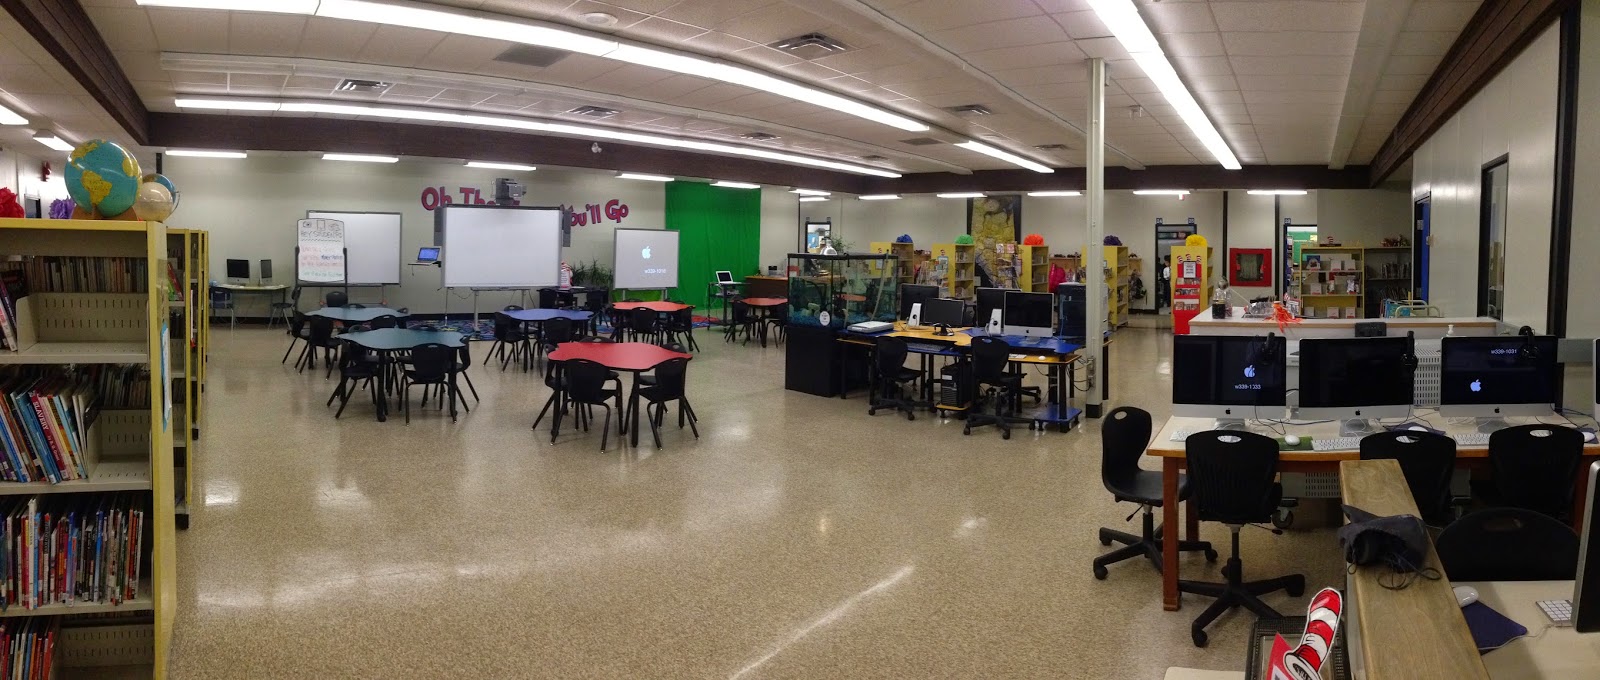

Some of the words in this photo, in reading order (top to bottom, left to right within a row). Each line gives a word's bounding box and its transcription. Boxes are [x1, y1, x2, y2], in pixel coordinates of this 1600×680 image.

[421, 186, 453, 211] Oh
[605, 199, 629, 223] Go
[33, 401, 49, 430] SLAVERY
